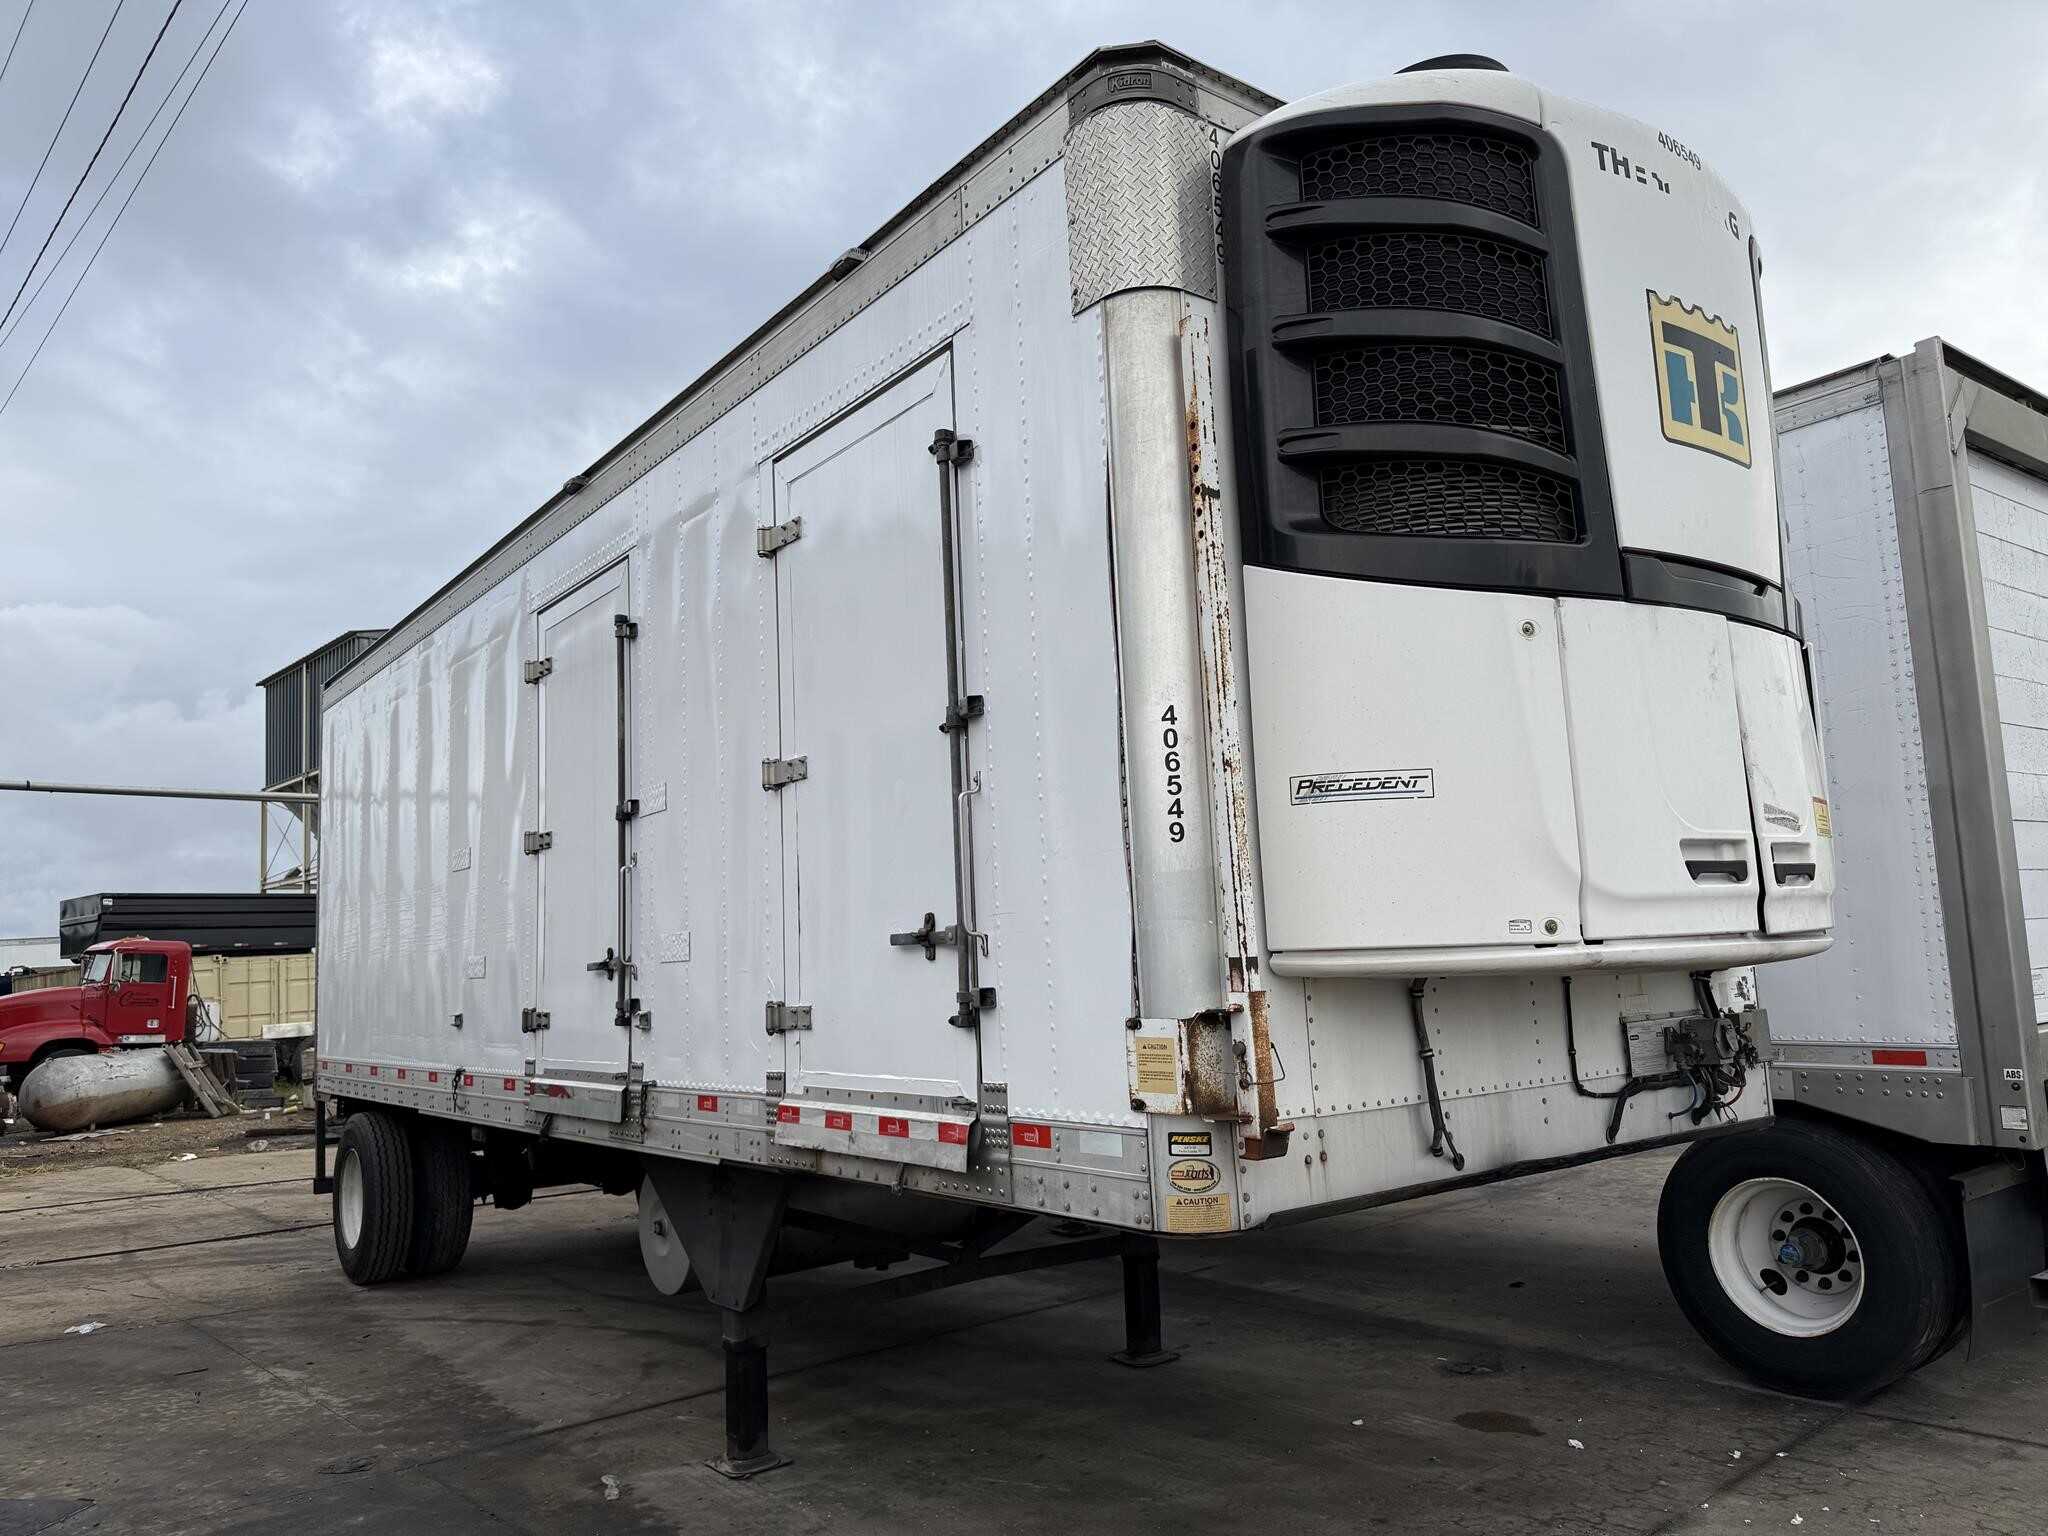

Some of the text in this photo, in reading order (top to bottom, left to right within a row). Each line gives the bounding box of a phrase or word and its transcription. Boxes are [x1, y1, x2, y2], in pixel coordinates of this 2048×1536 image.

[1657, 131, 1702, 171] 406549
[1160, 704, 1186, 843] 406549
[1296, 775, 1429, 795] PRECEDENT
[2006, 1070, 2021, 1079] ABS
[1171, 1135, 1210, 1143] PENSKE
[1183, 1196, 1219, 1206] CAUTION
